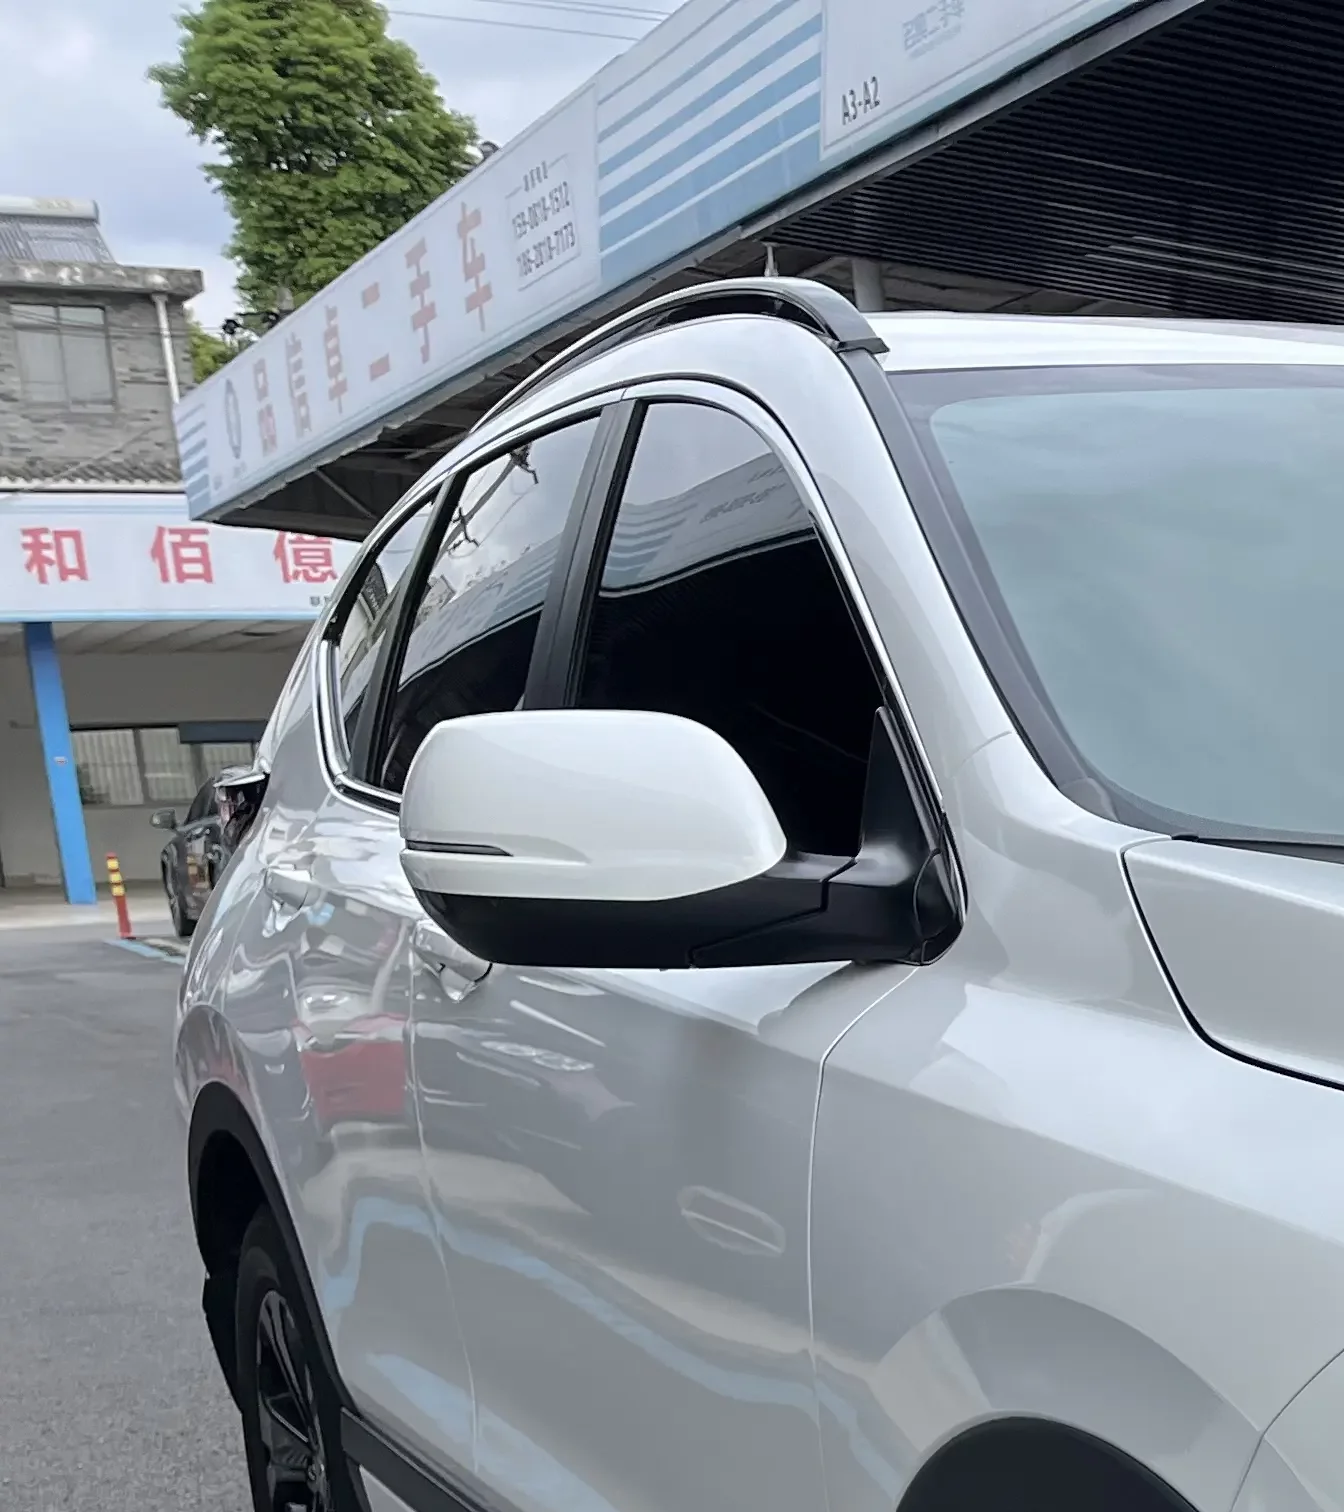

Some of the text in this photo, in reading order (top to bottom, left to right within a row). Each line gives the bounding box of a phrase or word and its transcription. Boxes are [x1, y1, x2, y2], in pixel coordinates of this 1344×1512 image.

[842, 76, 881, 125] A3-A2
[20, 526, 338, 584] 和佰億
